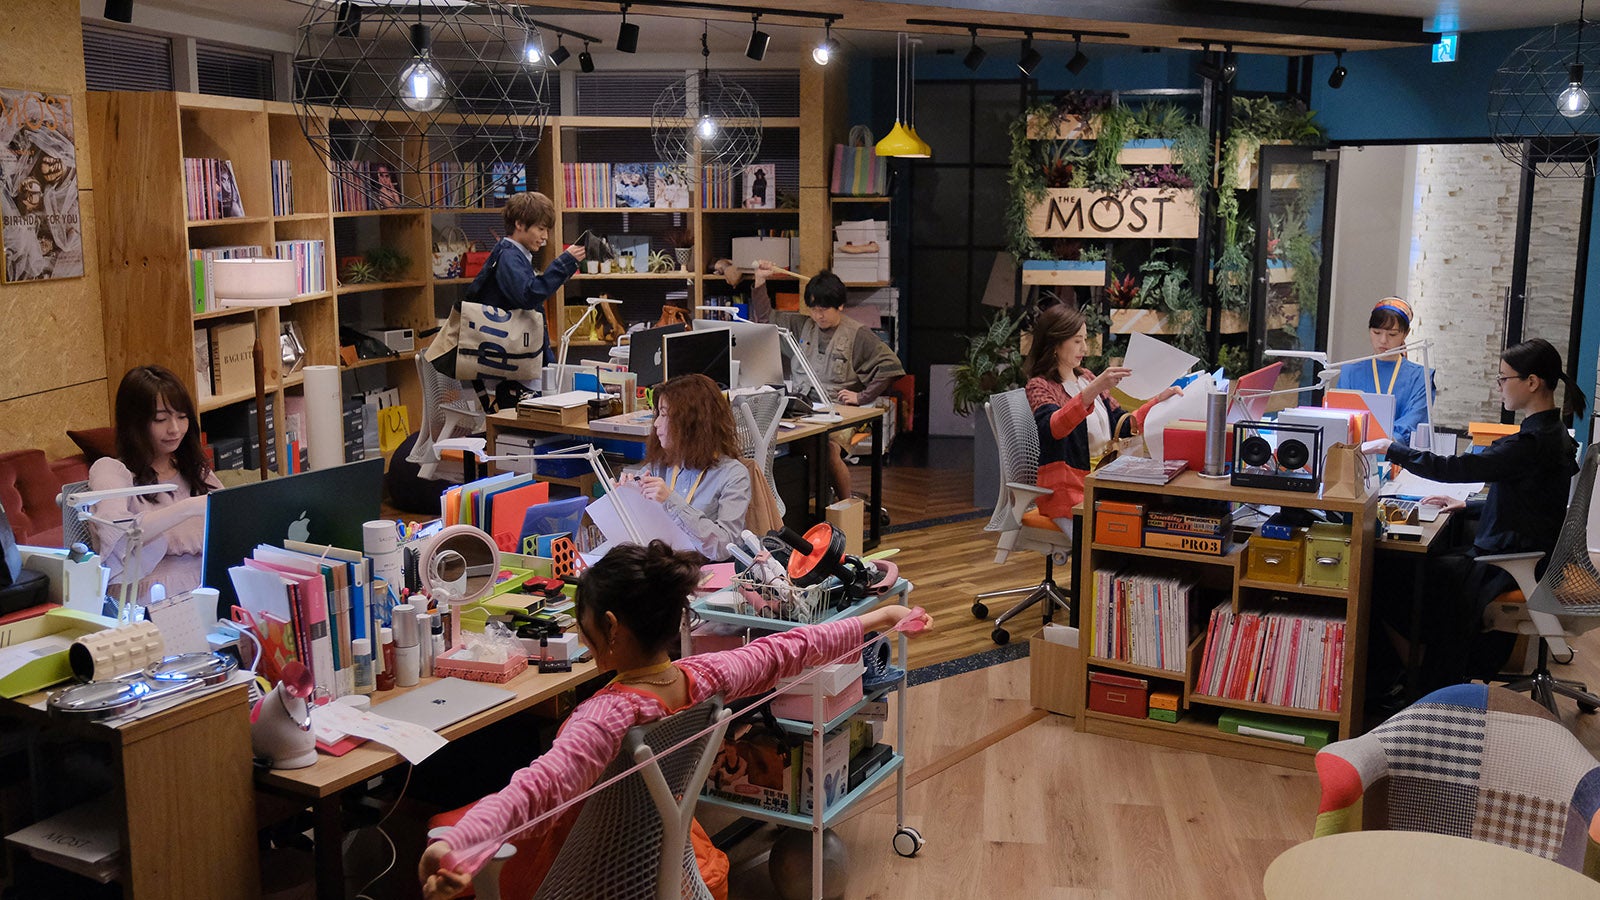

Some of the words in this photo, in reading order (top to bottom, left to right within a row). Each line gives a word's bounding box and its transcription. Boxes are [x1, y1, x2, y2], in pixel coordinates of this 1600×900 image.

[0, 94, 68, 131] MOST
[1058, 195, 1076, 204] THE
[3, 215, 43, 226] BIRTHDAY
[46, 214, 60, 225] FOR
[62, 214, 78, 224] YOU
[1045, 196, 1173, 233] MOST
[224, 351, 254, 364] BAGUETT
[1149, 514, 1182, 523] Quality
